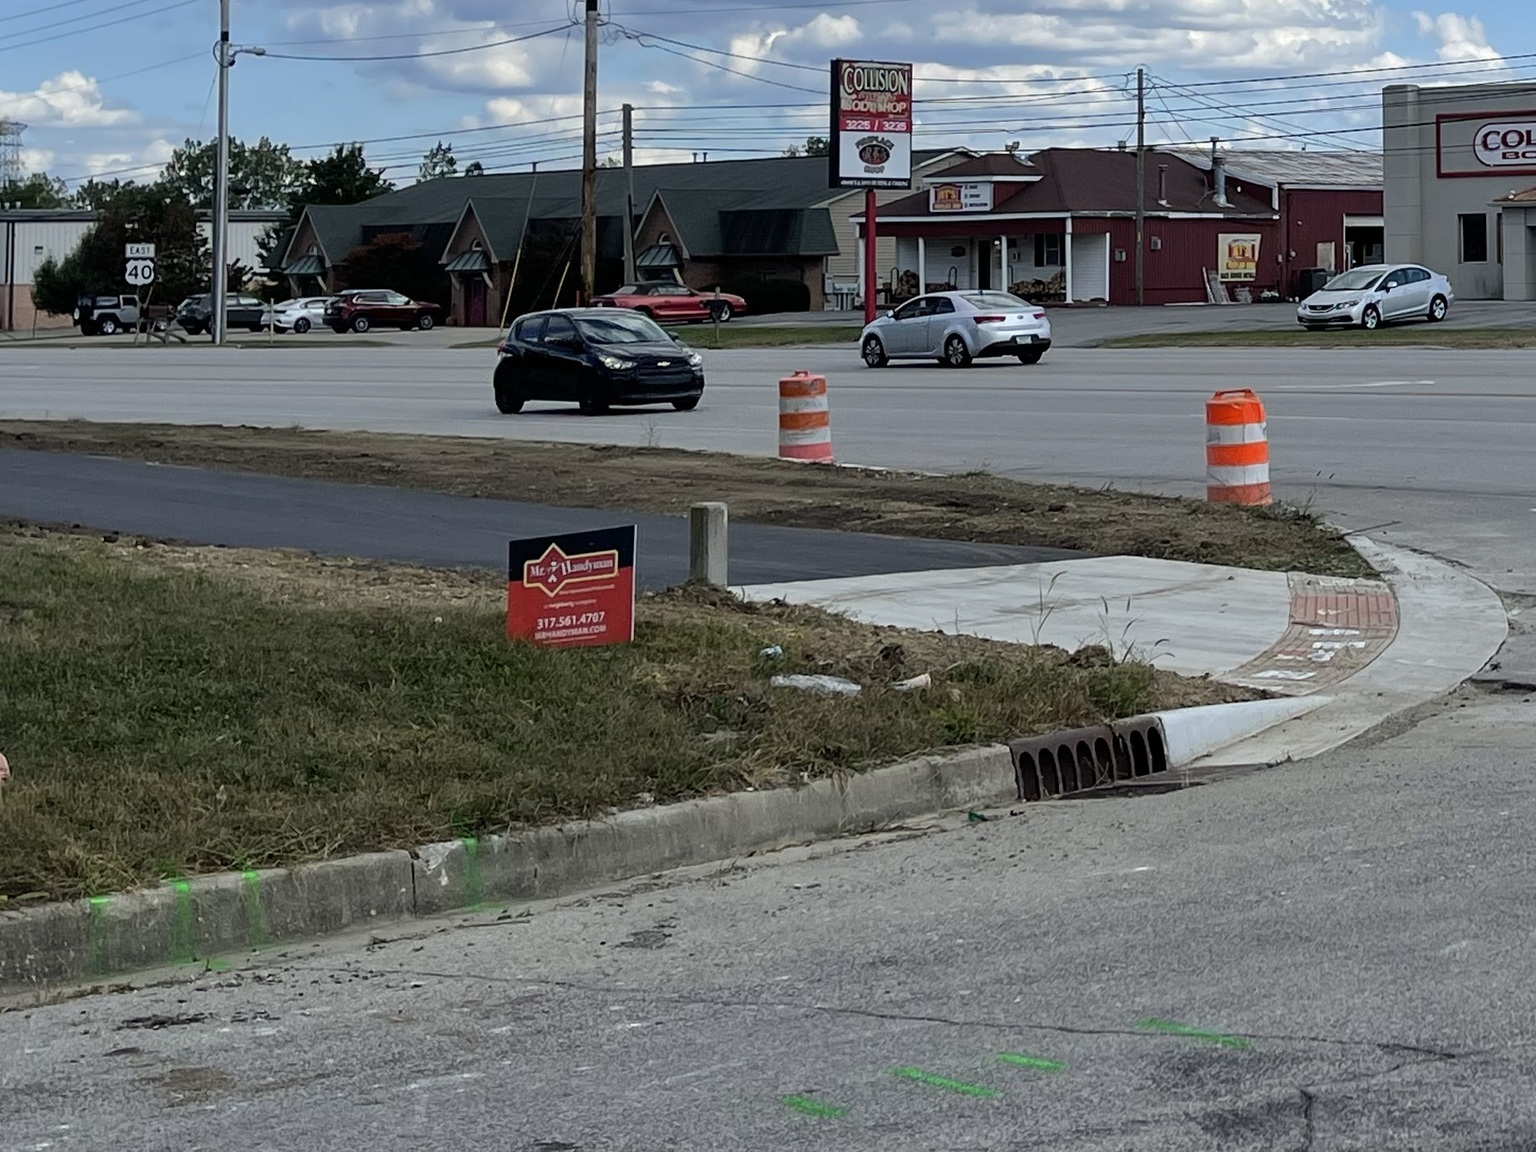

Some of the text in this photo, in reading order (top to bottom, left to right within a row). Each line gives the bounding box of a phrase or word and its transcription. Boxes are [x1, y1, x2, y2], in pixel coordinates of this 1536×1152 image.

[843, 67, 908, 96] COLLISION
[130, 246, 150, 255] EAST
[128, 264, 152, 280] 40
[561, 559, 614, 576] Handyman
[536, 611, 606, 630] 317.561.4707
